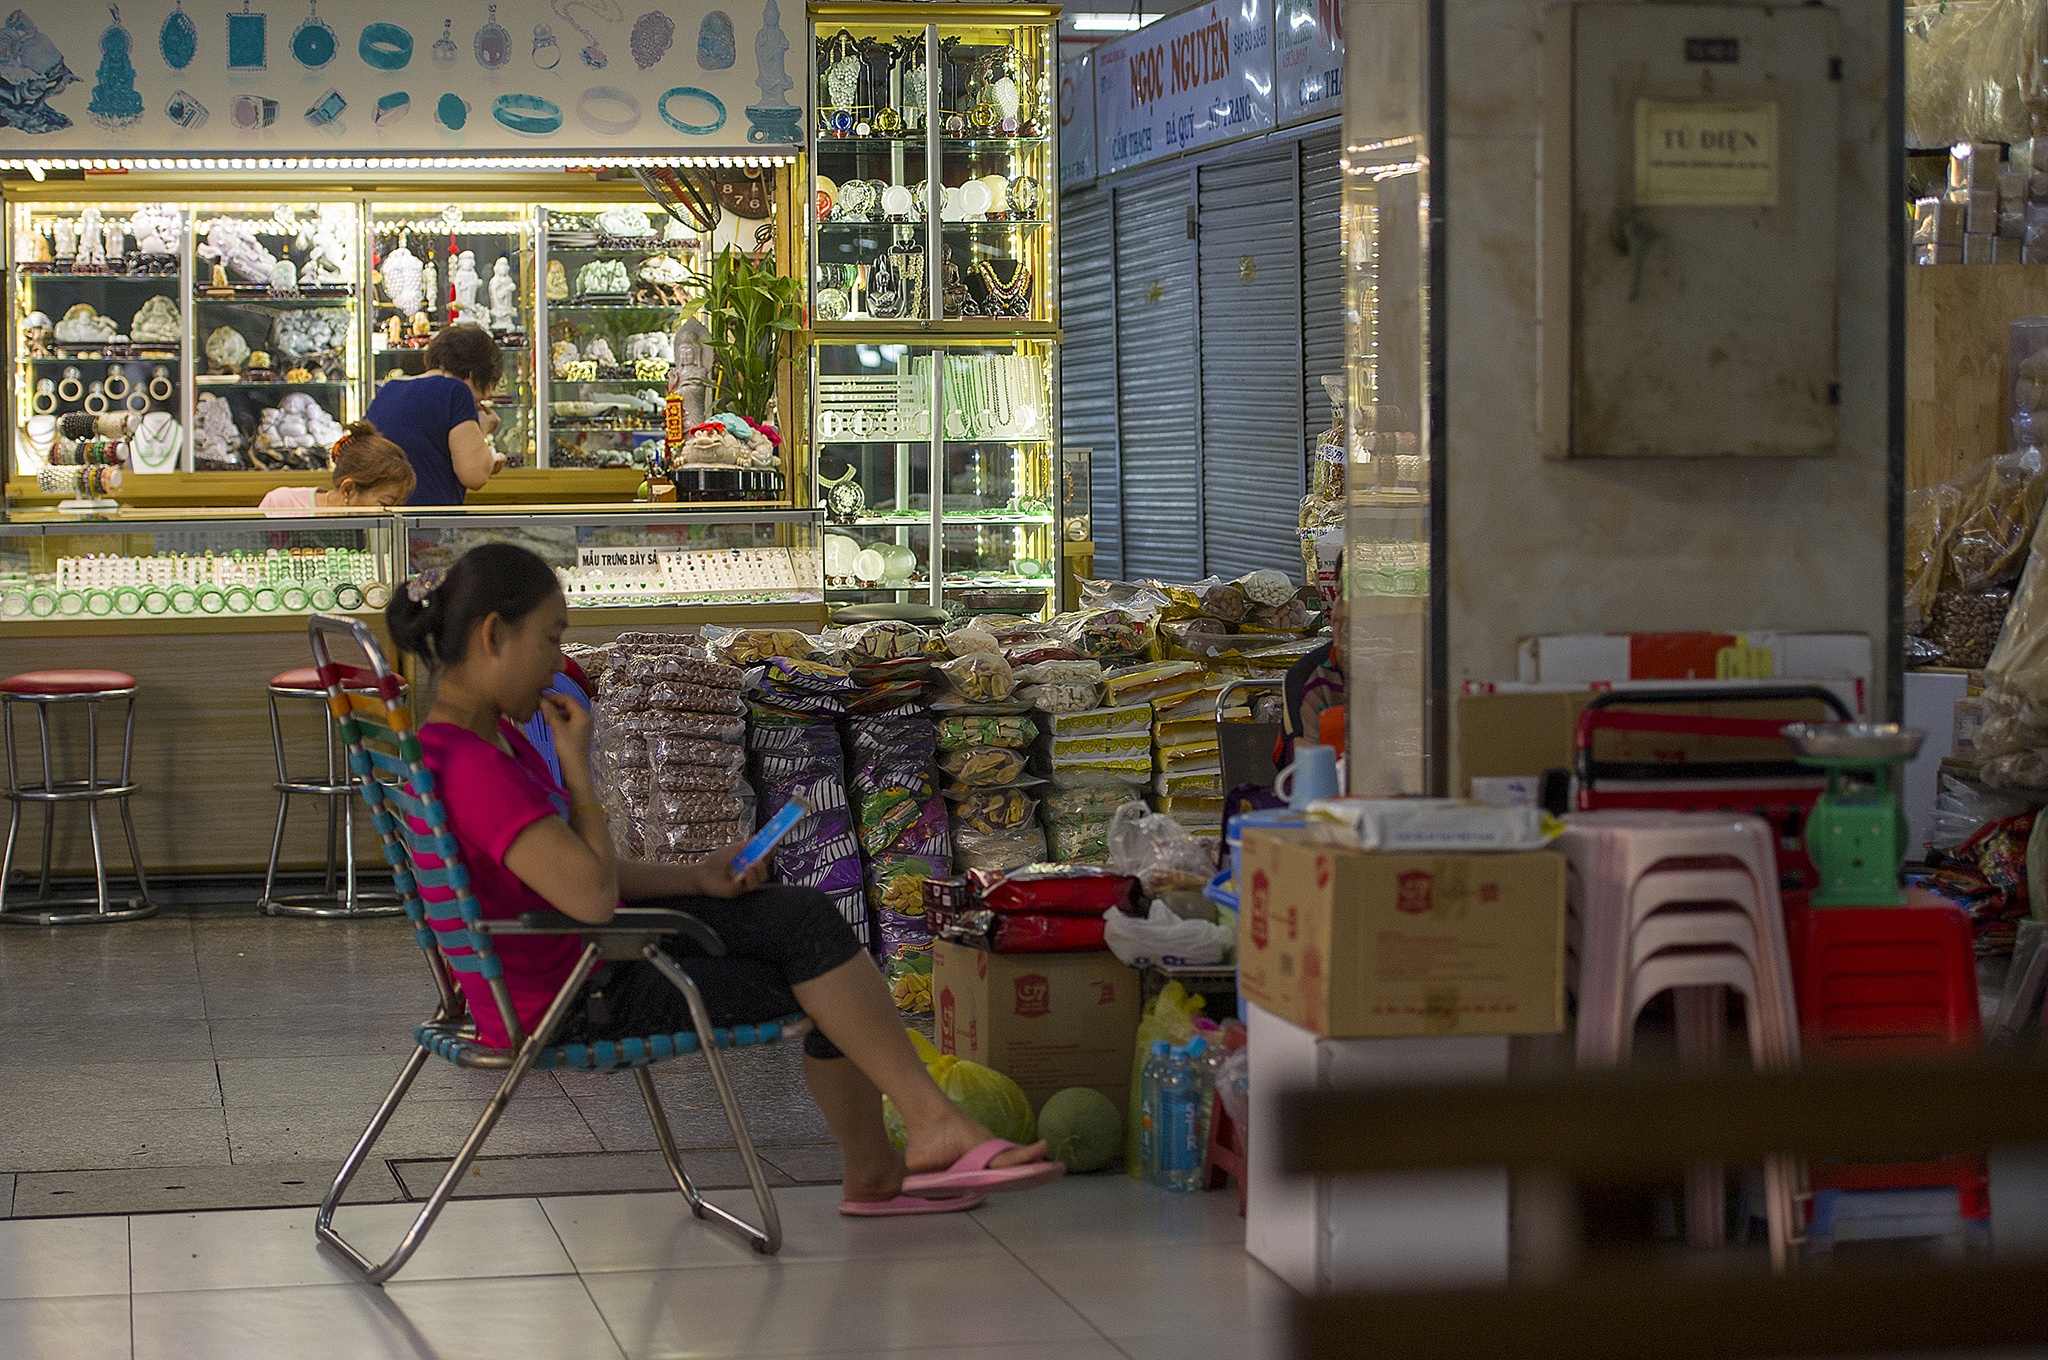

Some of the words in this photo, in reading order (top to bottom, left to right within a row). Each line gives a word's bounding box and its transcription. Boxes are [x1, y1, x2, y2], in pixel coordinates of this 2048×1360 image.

[1129, 44, 1164, 117] NGỌC
[1171, 8, 1231, 95] NGUYÊN
[1222, 94, 1252, 127] TRANG
[1178, 106, 1195, 148] QUÝ
[722, 183, 733, 194] 8
[734, 194, 744, 206] 7
[749, 199, 760, 209] 6
[582, 549, 600, 566] MẪU
[601, 552, 628, 566] TRƯNG
[629, 551, 646, 566] BÀY
[647, 549, 659, 565] SẢ
